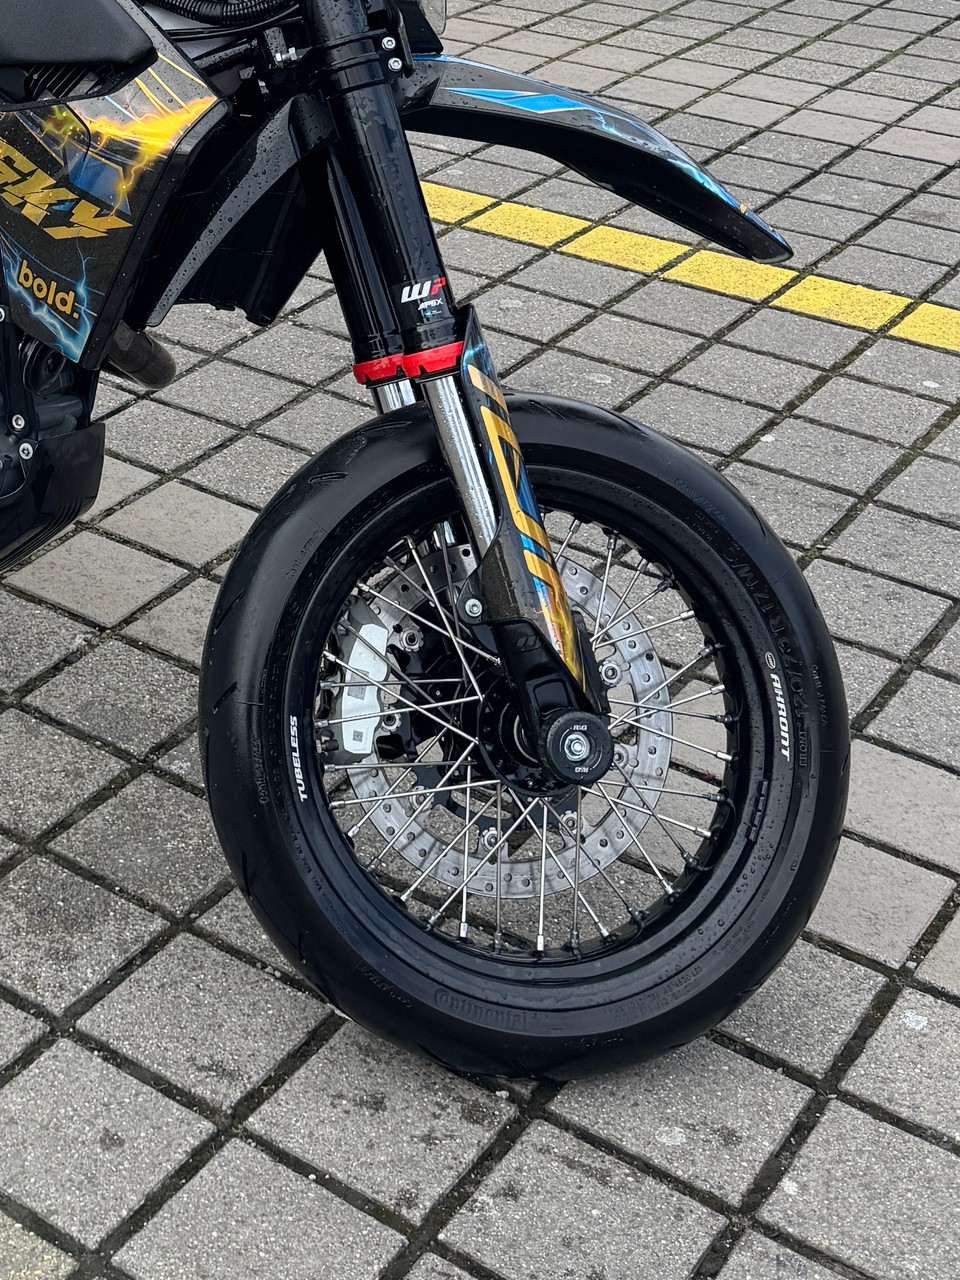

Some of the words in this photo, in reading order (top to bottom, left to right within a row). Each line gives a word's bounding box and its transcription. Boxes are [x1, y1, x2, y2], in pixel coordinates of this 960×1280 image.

[18, 260, 79, 319] bold.
[290, 714, 310, 803] TUBELESS
[433, 987, 528, 1031] Continental
